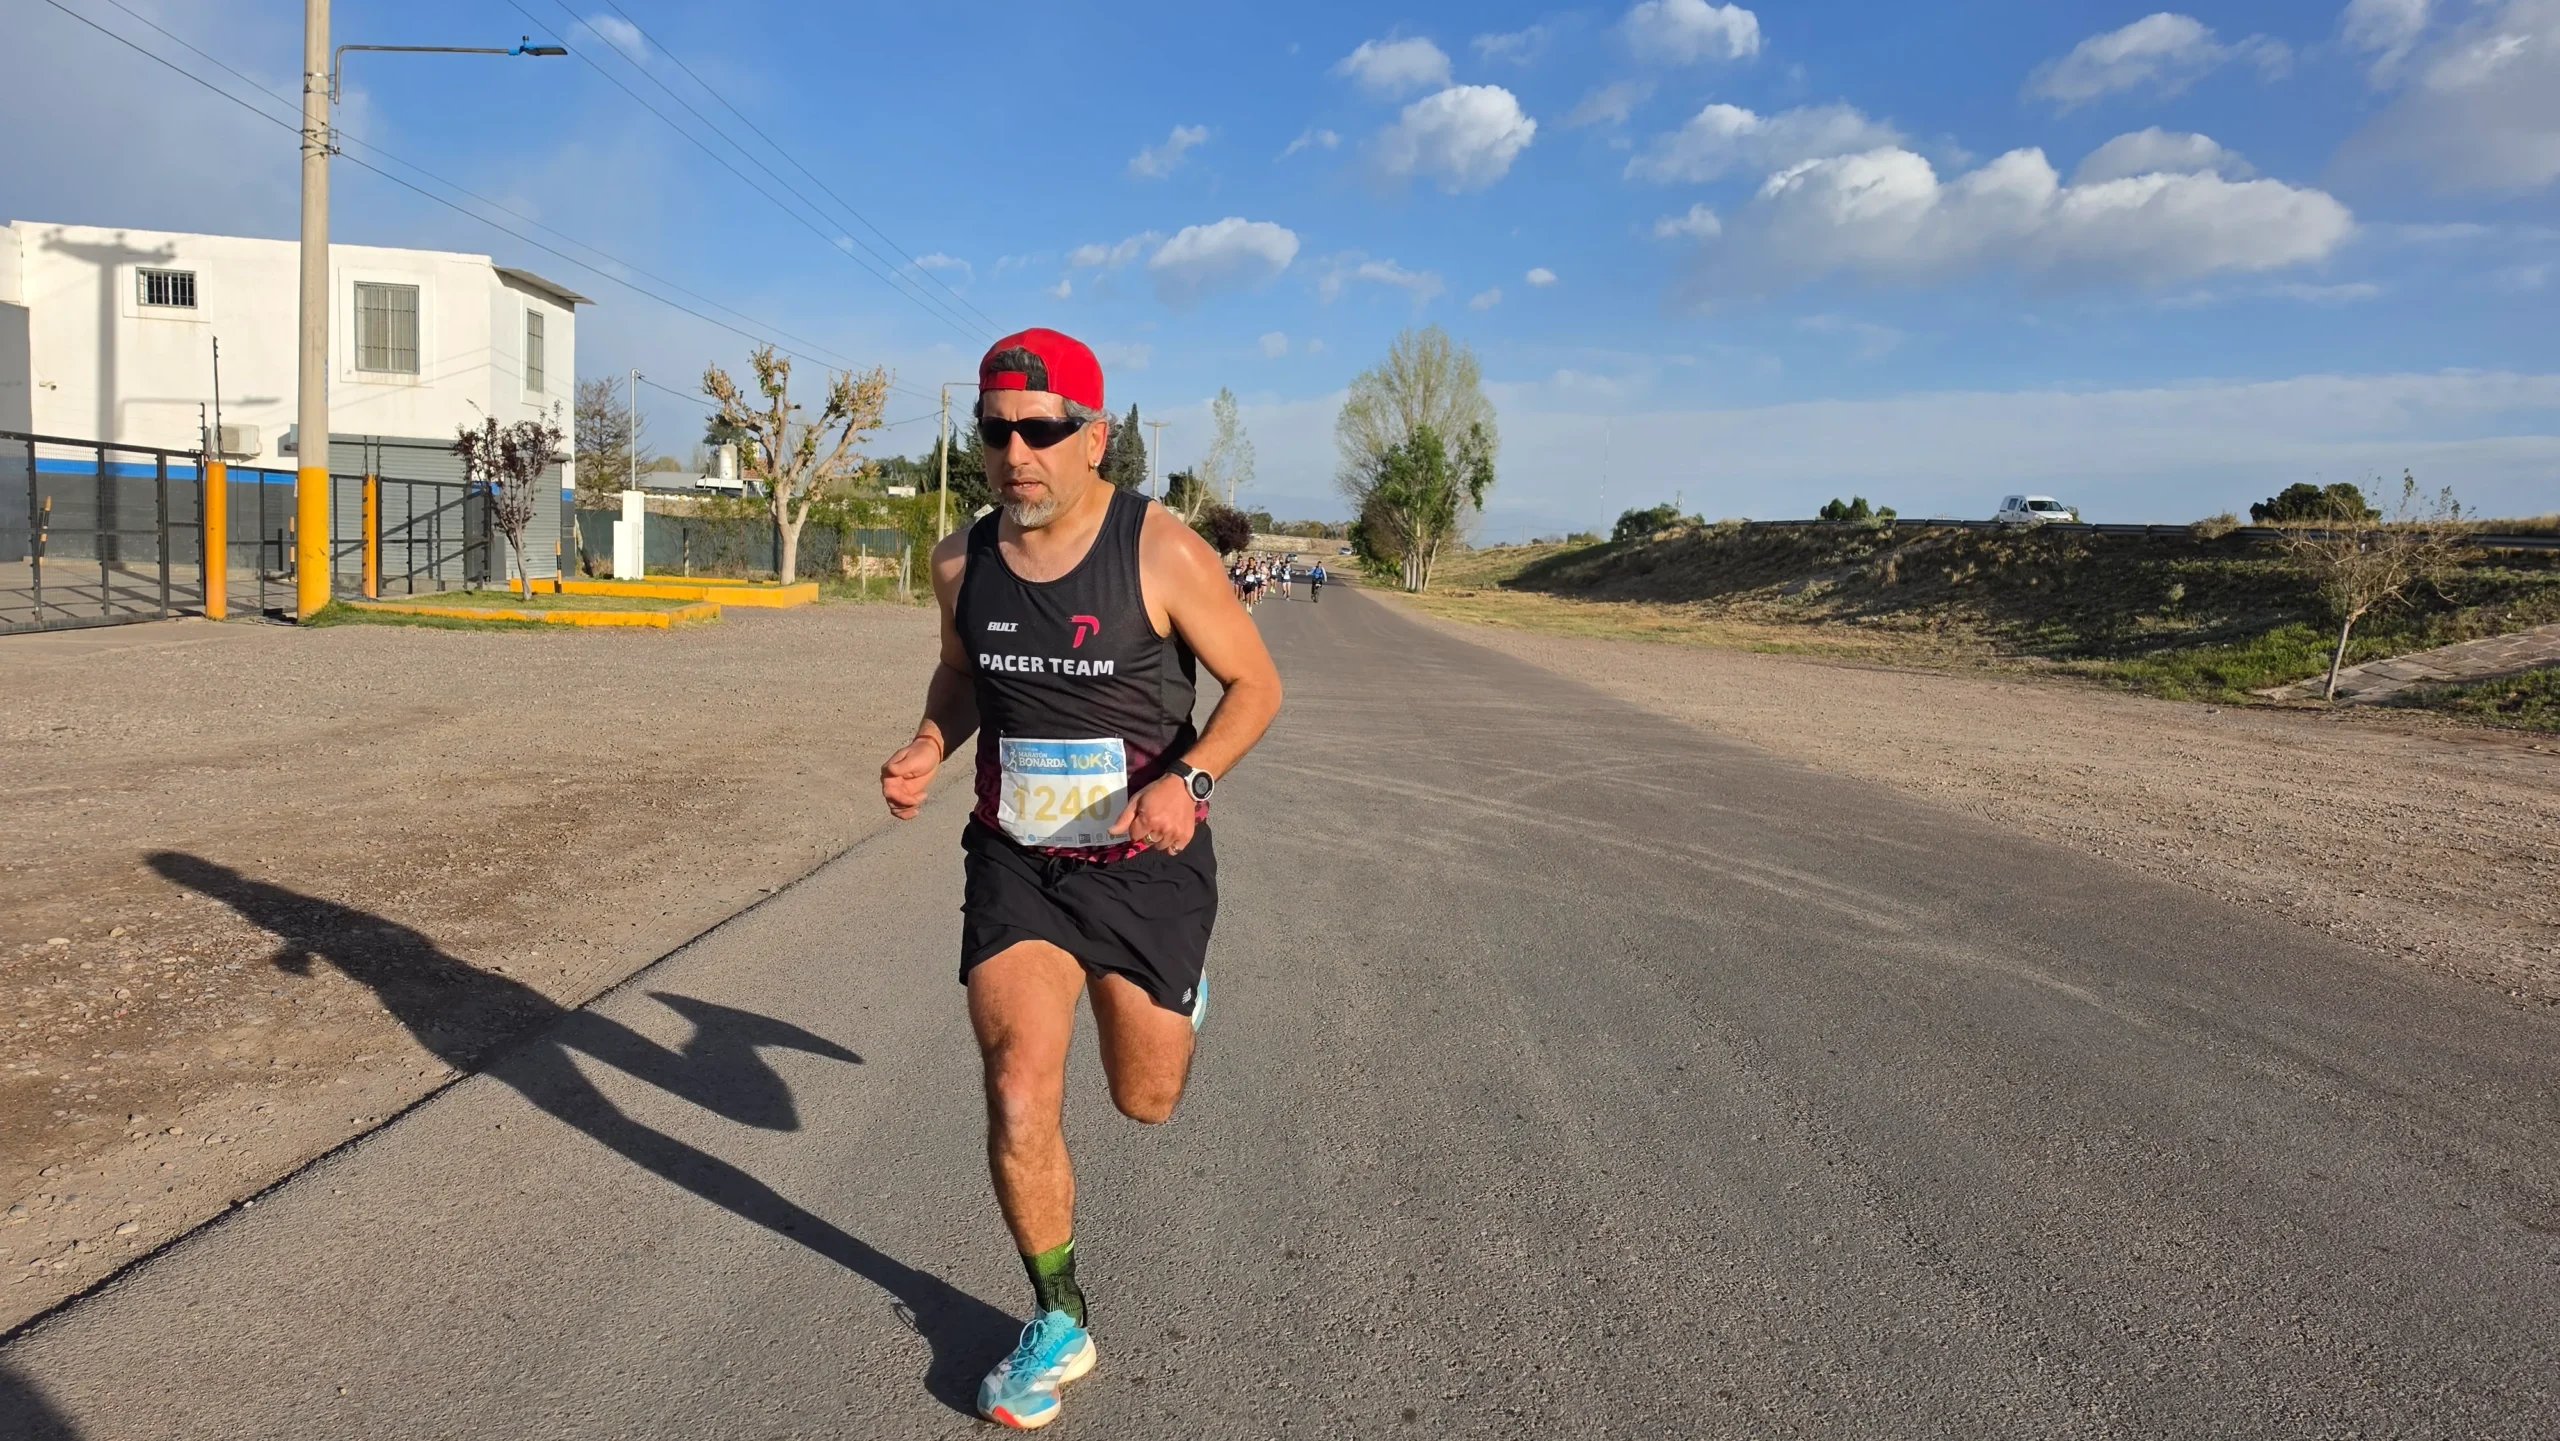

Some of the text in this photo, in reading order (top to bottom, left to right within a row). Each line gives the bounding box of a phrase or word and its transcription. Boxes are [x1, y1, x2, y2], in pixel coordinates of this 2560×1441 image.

[980, 653, 1114, 676] PACER TEAM
[1019, 753, 1103, 769] BONARDA 10K
[1013, 784, 1112, 821] 1240
